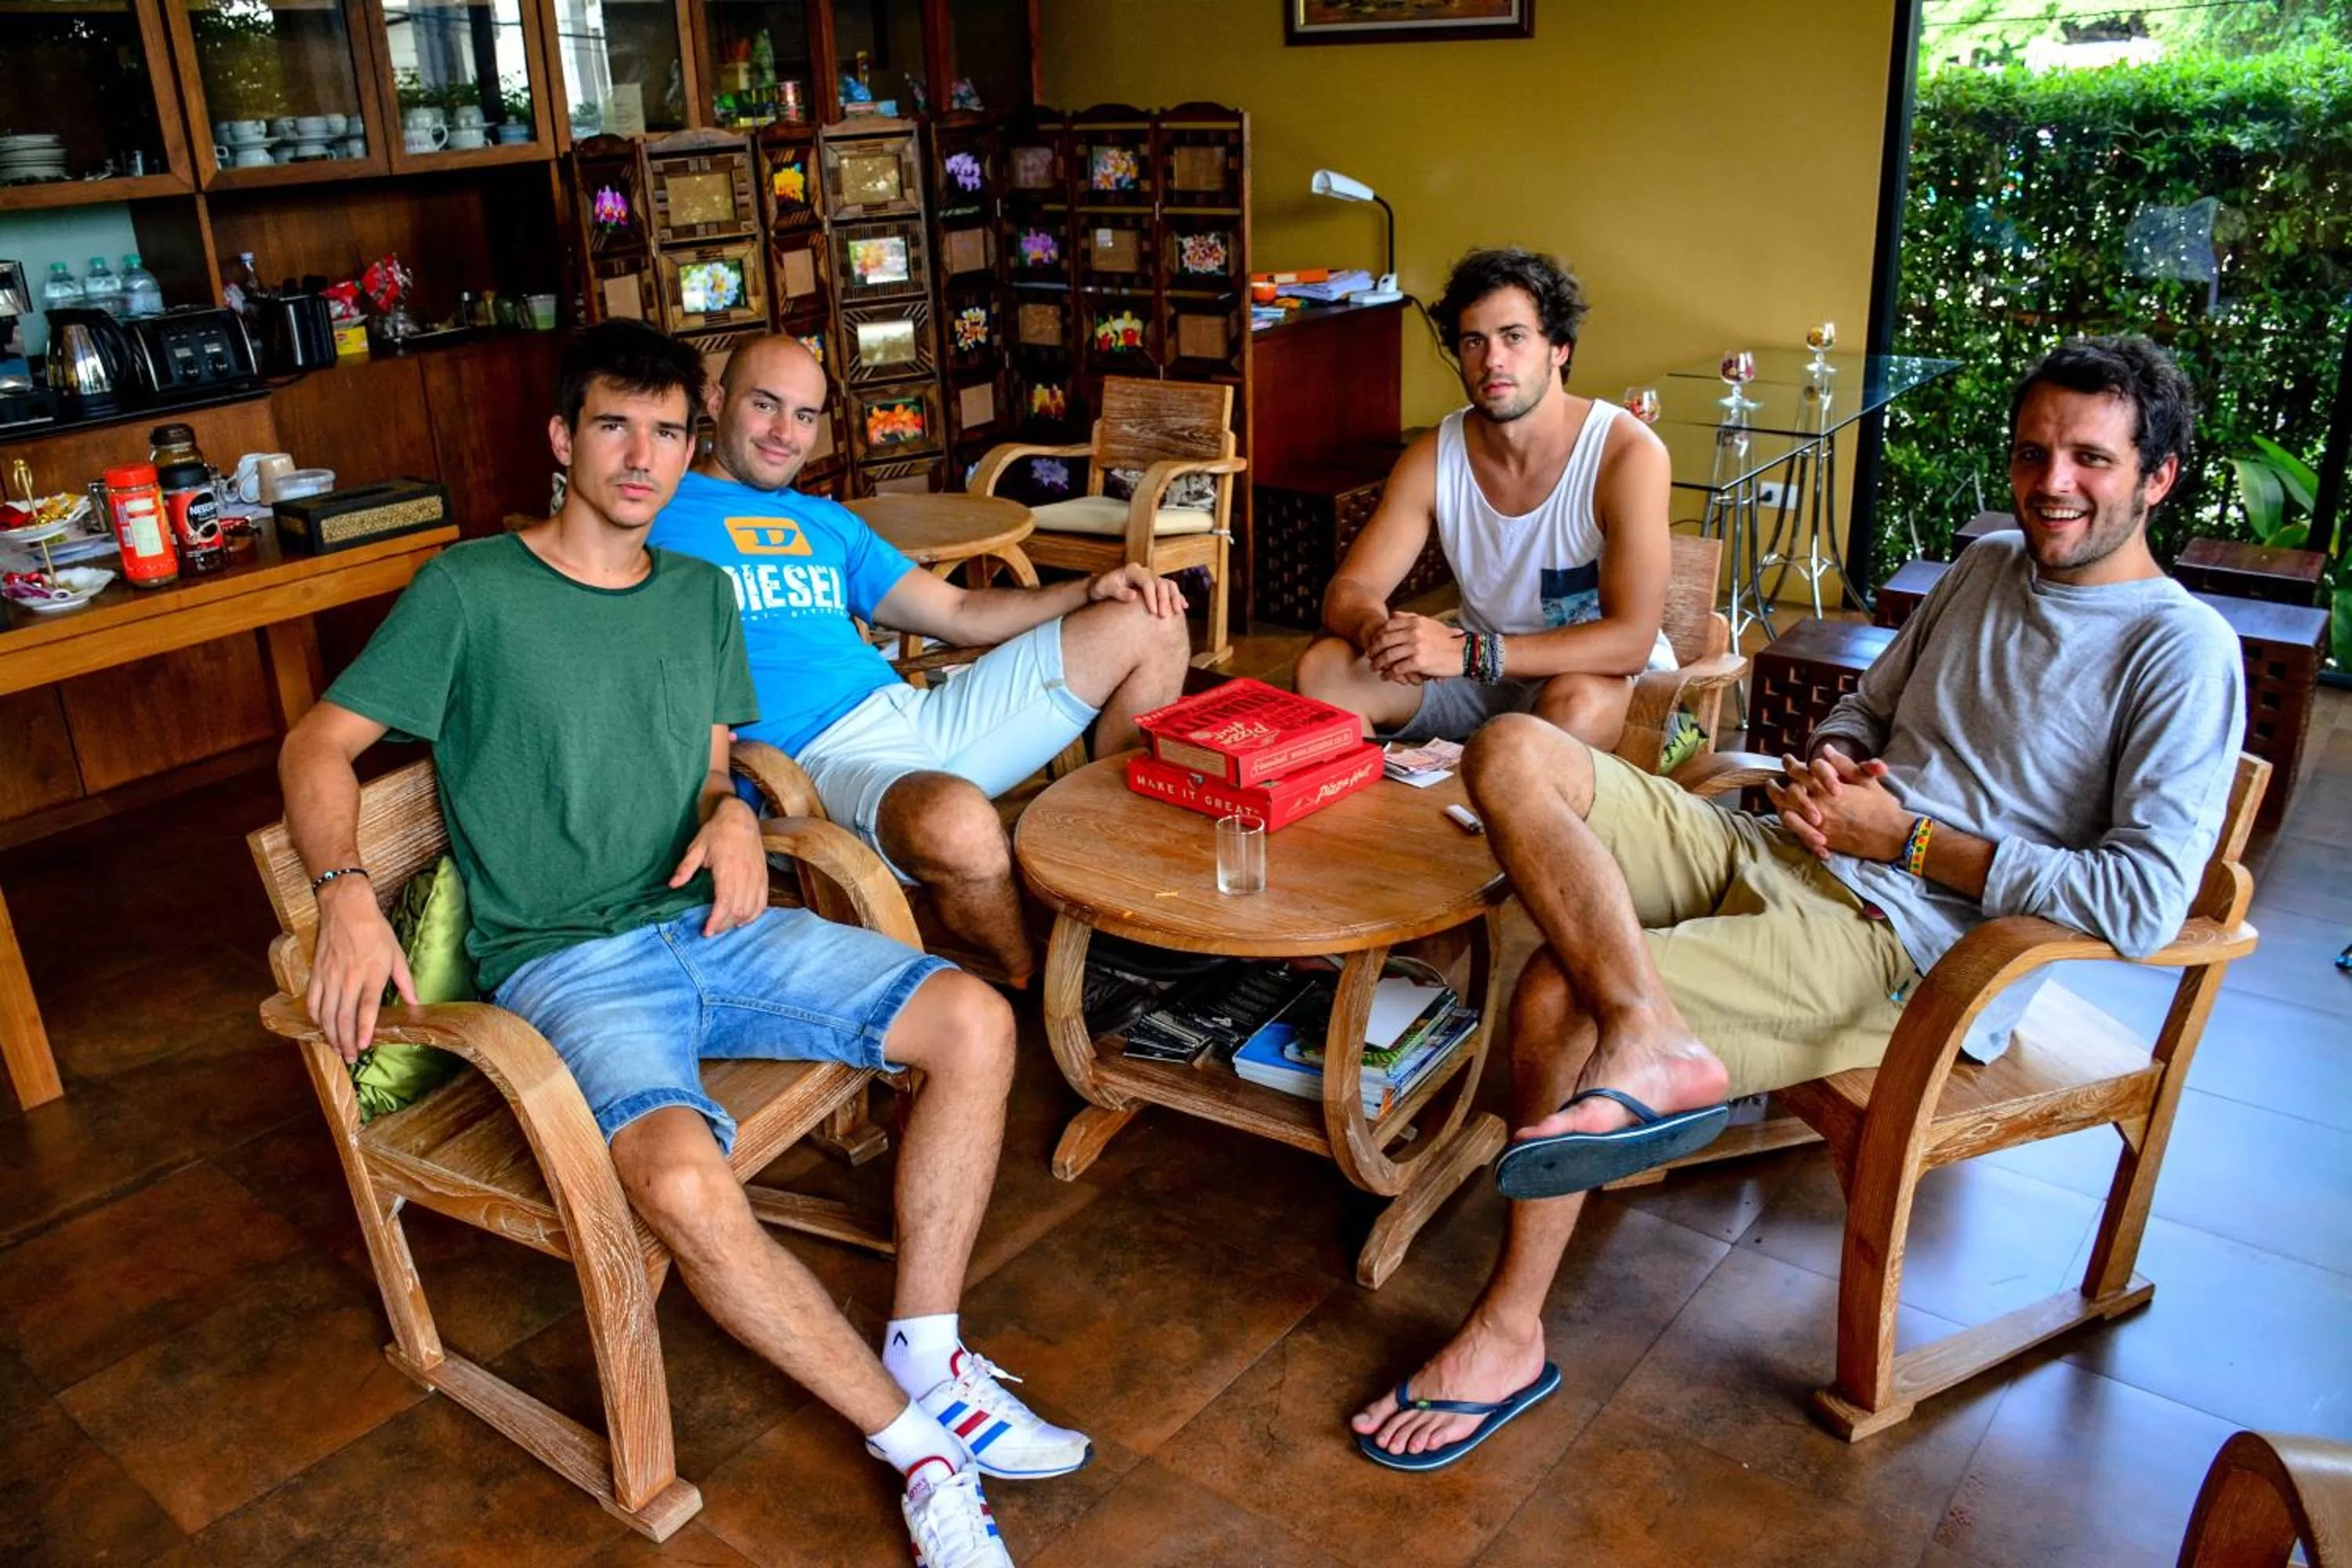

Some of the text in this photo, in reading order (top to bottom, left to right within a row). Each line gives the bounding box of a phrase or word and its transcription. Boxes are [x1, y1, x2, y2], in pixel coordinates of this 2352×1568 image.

[1137, 774, 1253, 816] MAKE IT GREAT
[1315, 763, 1374, 805] Pizza Hut
